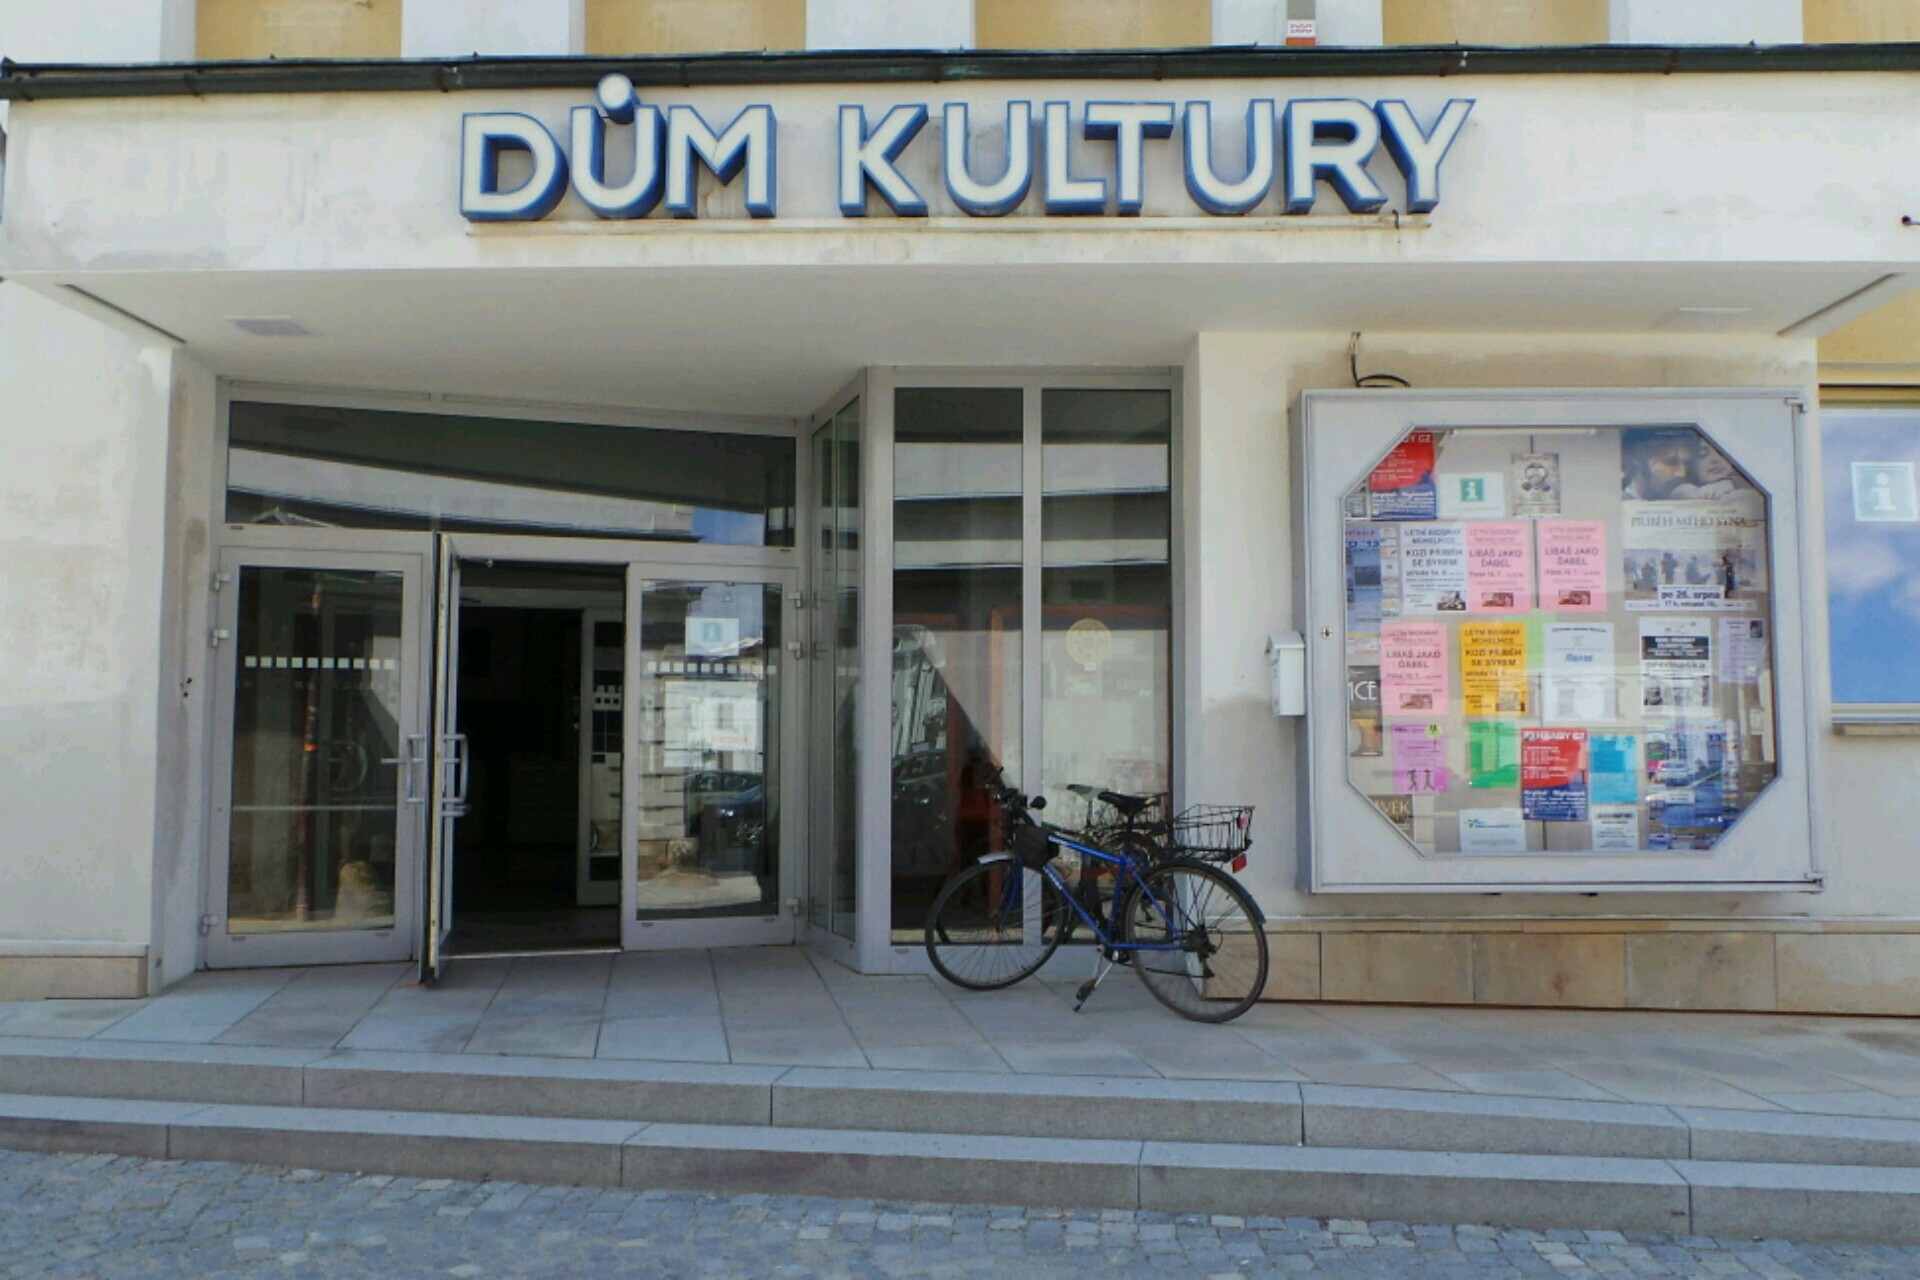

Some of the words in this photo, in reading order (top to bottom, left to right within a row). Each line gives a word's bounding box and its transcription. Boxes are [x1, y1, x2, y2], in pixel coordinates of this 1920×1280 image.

[461, 73, 777, 222] DŮM
[838, 98, 1477, 218] KULTURY
[1498, 548, 1523, 558] JAKO
[1574, 546, 1599, 556] JAKO
[1412, 558, 1424, 567] SE
[1693, 591, 1721, 601] srpna
[1416, 650, 1442, 658] JAKO
